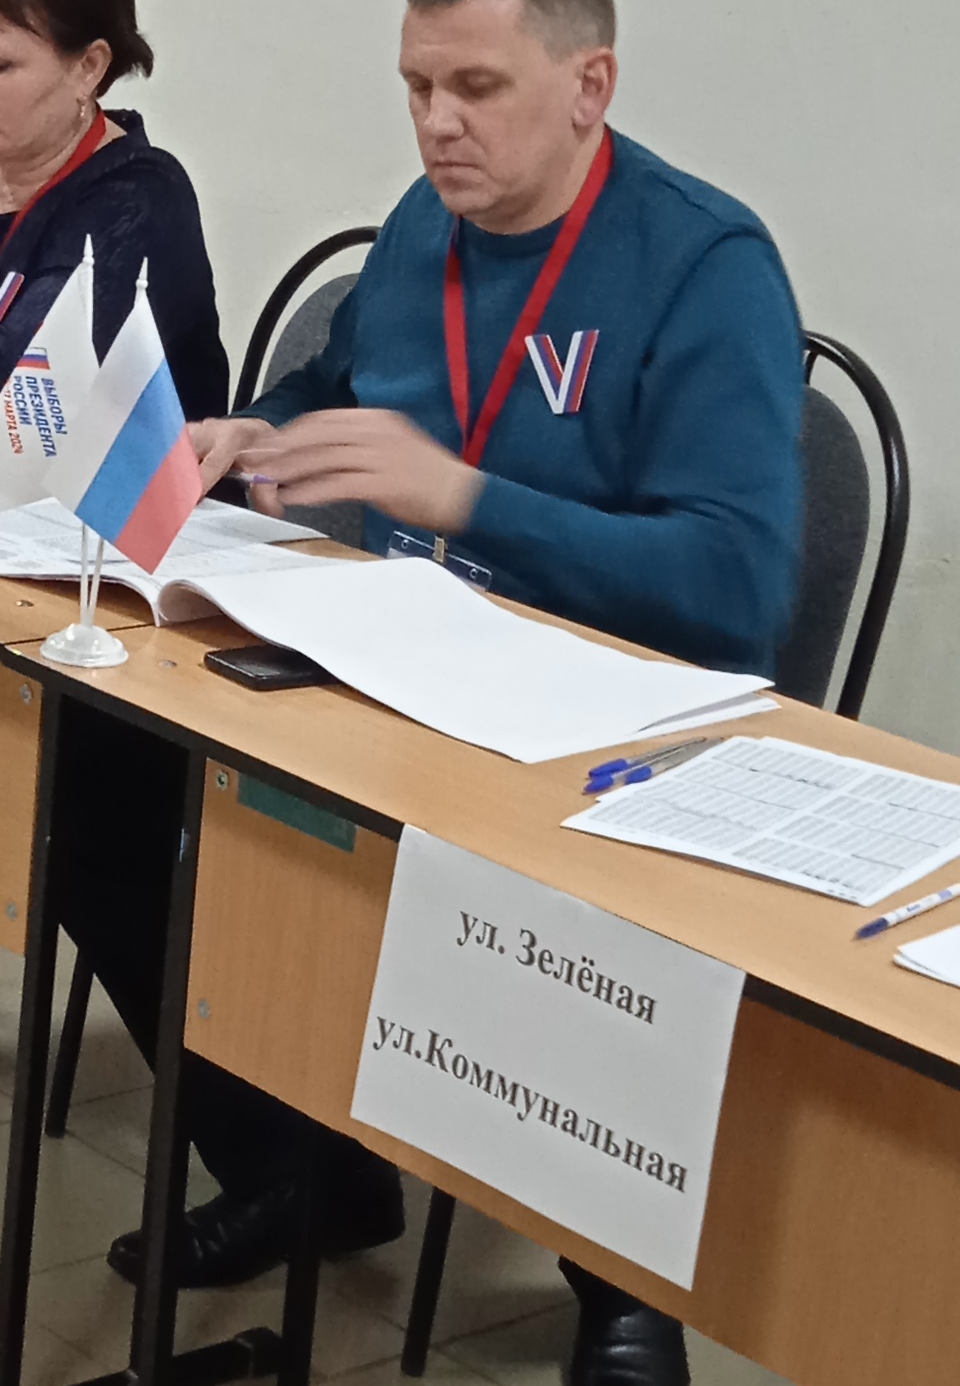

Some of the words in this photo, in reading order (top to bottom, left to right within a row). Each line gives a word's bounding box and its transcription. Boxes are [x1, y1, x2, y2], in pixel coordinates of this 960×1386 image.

[4, 400, 18, 431] МАРТА
[13, 375, 33, 426] РОССИИ
[25, 376, 57, 457] ПРЕЗИДЕНТА
[41, 378, 68, 435] ВЫБОРЫ
[456, 910, 506, 955] ул.
[515, 928, 658, 1025] Зелёная
